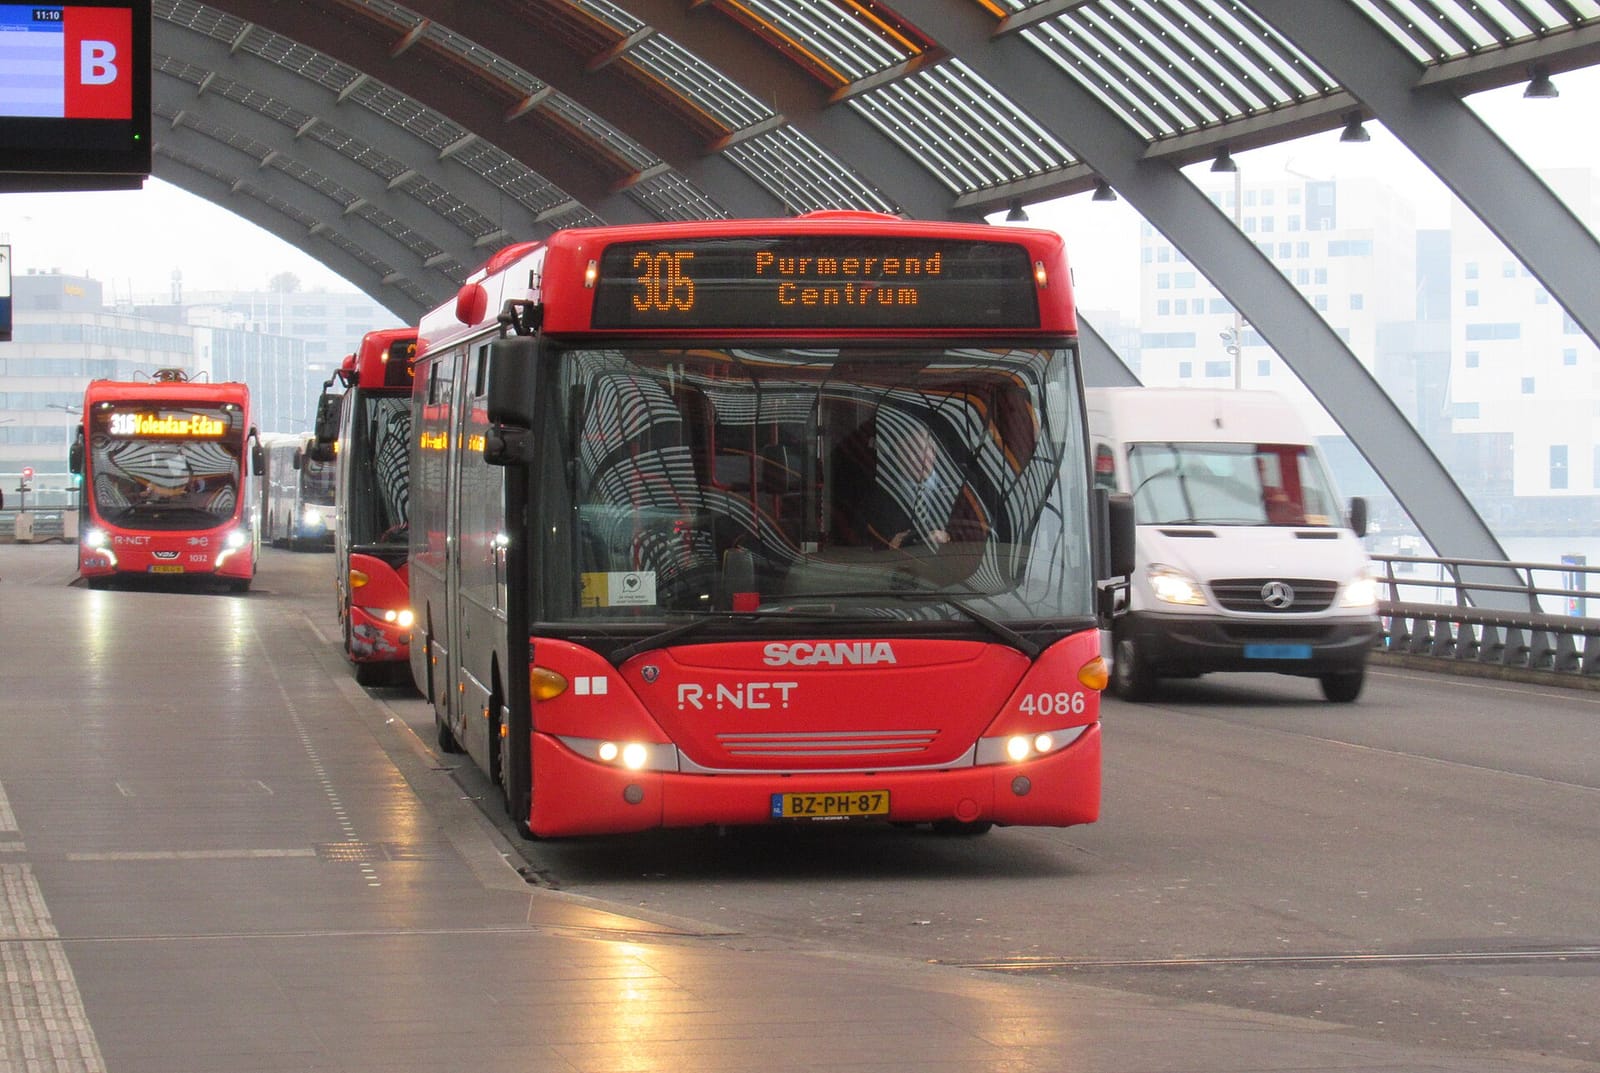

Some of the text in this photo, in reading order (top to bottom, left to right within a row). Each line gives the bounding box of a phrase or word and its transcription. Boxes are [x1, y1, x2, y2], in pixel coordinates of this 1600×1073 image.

[36, 11, 60, 20] 11:10
[80, 40, 118, 85] B
[756, 252, 942, 274] Purmerend
[633, 252, 694, 311] 305
[777, 283, 919, 305] Centrum
[763, 642, 897, 666] SCANIA
[1019, 692, 1085, 716] 4086
[791, 795, 882, 814] BZ-PH-87
